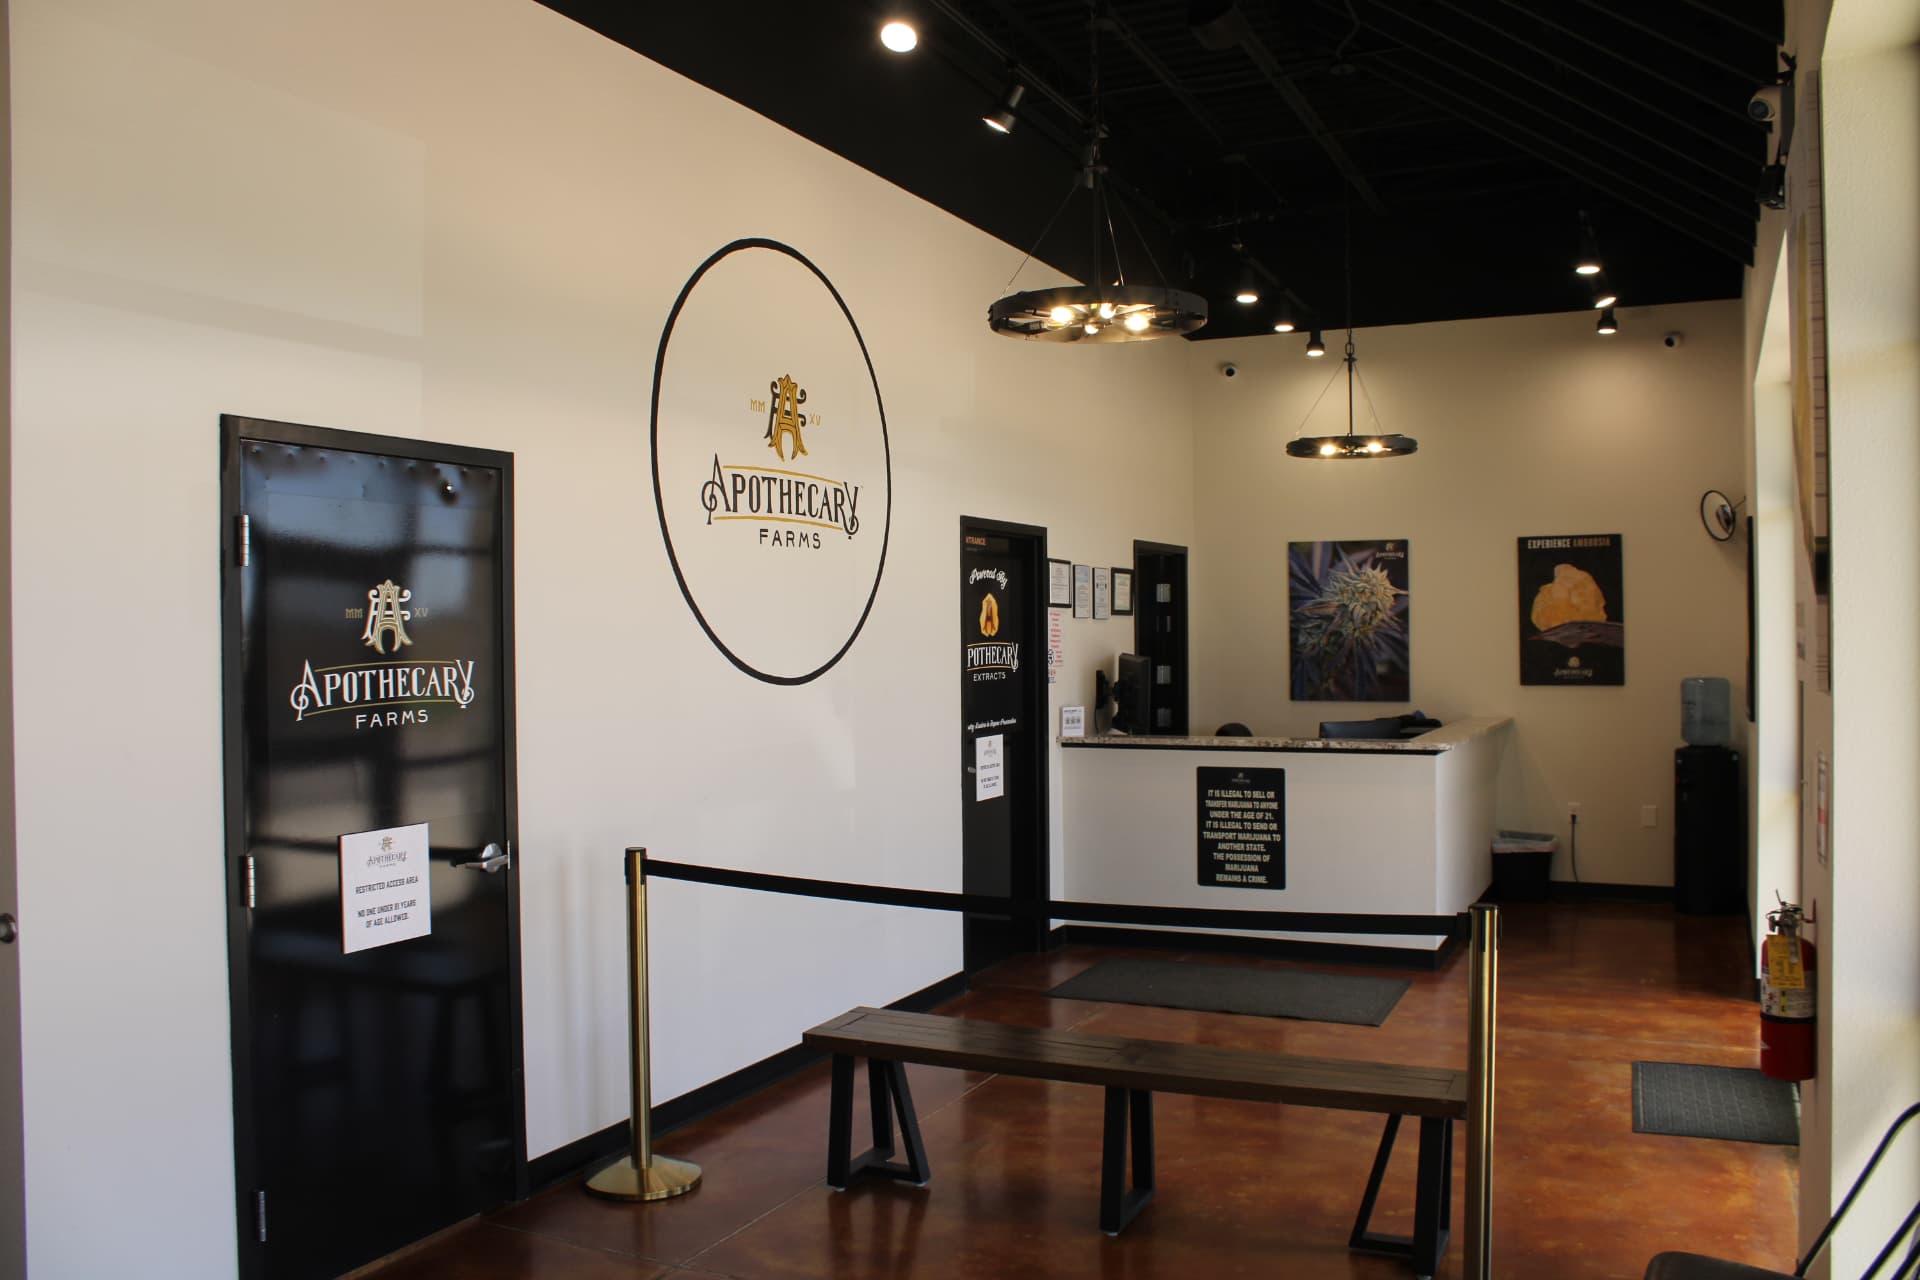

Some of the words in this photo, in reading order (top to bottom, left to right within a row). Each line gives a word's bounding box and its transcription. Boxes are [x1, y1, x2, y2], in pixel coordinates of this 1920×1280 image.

[750, 398, 766, 413] MM
[809, 413, 821, 426] XV
[701, 452, 859, 539] APOTHECARY
[759, 528, 821, 549] FARMS
[1528, 538, 1571, 549] EXPERIENCE
[345, 608, 363, 619] MM
[414, 607, 428, 618] XV
[967, 642, 1018, 672] POTHECARY
[973, 672, 1006, 682] EXTRACTS
[290, 658, 475, 721] APOTHECARY
[355, 709, 429, 729] FARMS
[1221, 790, 1243, 798] ILLEGAL
[1203, 832, 1237, 840] TRANSPORT
[1238, 833, 1271, 841] MARIJUANA
[1218, 842, 1245, 851] ANOTHER
[1226, 853, 1261, 862] POSSESSION
[1225, 864, 1259, 872] MARIJUANA
[1216, 874, 1241, 882] REMAINS
[356, 882, 385, 894] RESTRICTED
[386, 878, 405, 888] ACCESS
[406, 876, 418, 884] AREA
[366, 908, 376, 916] ONE
[378, 904, 393, 913] UNDER
[401, 899, 416, 909] YEARS
[366, 920, 372, 928] OF
[374, 918, 383, 926] AGE
